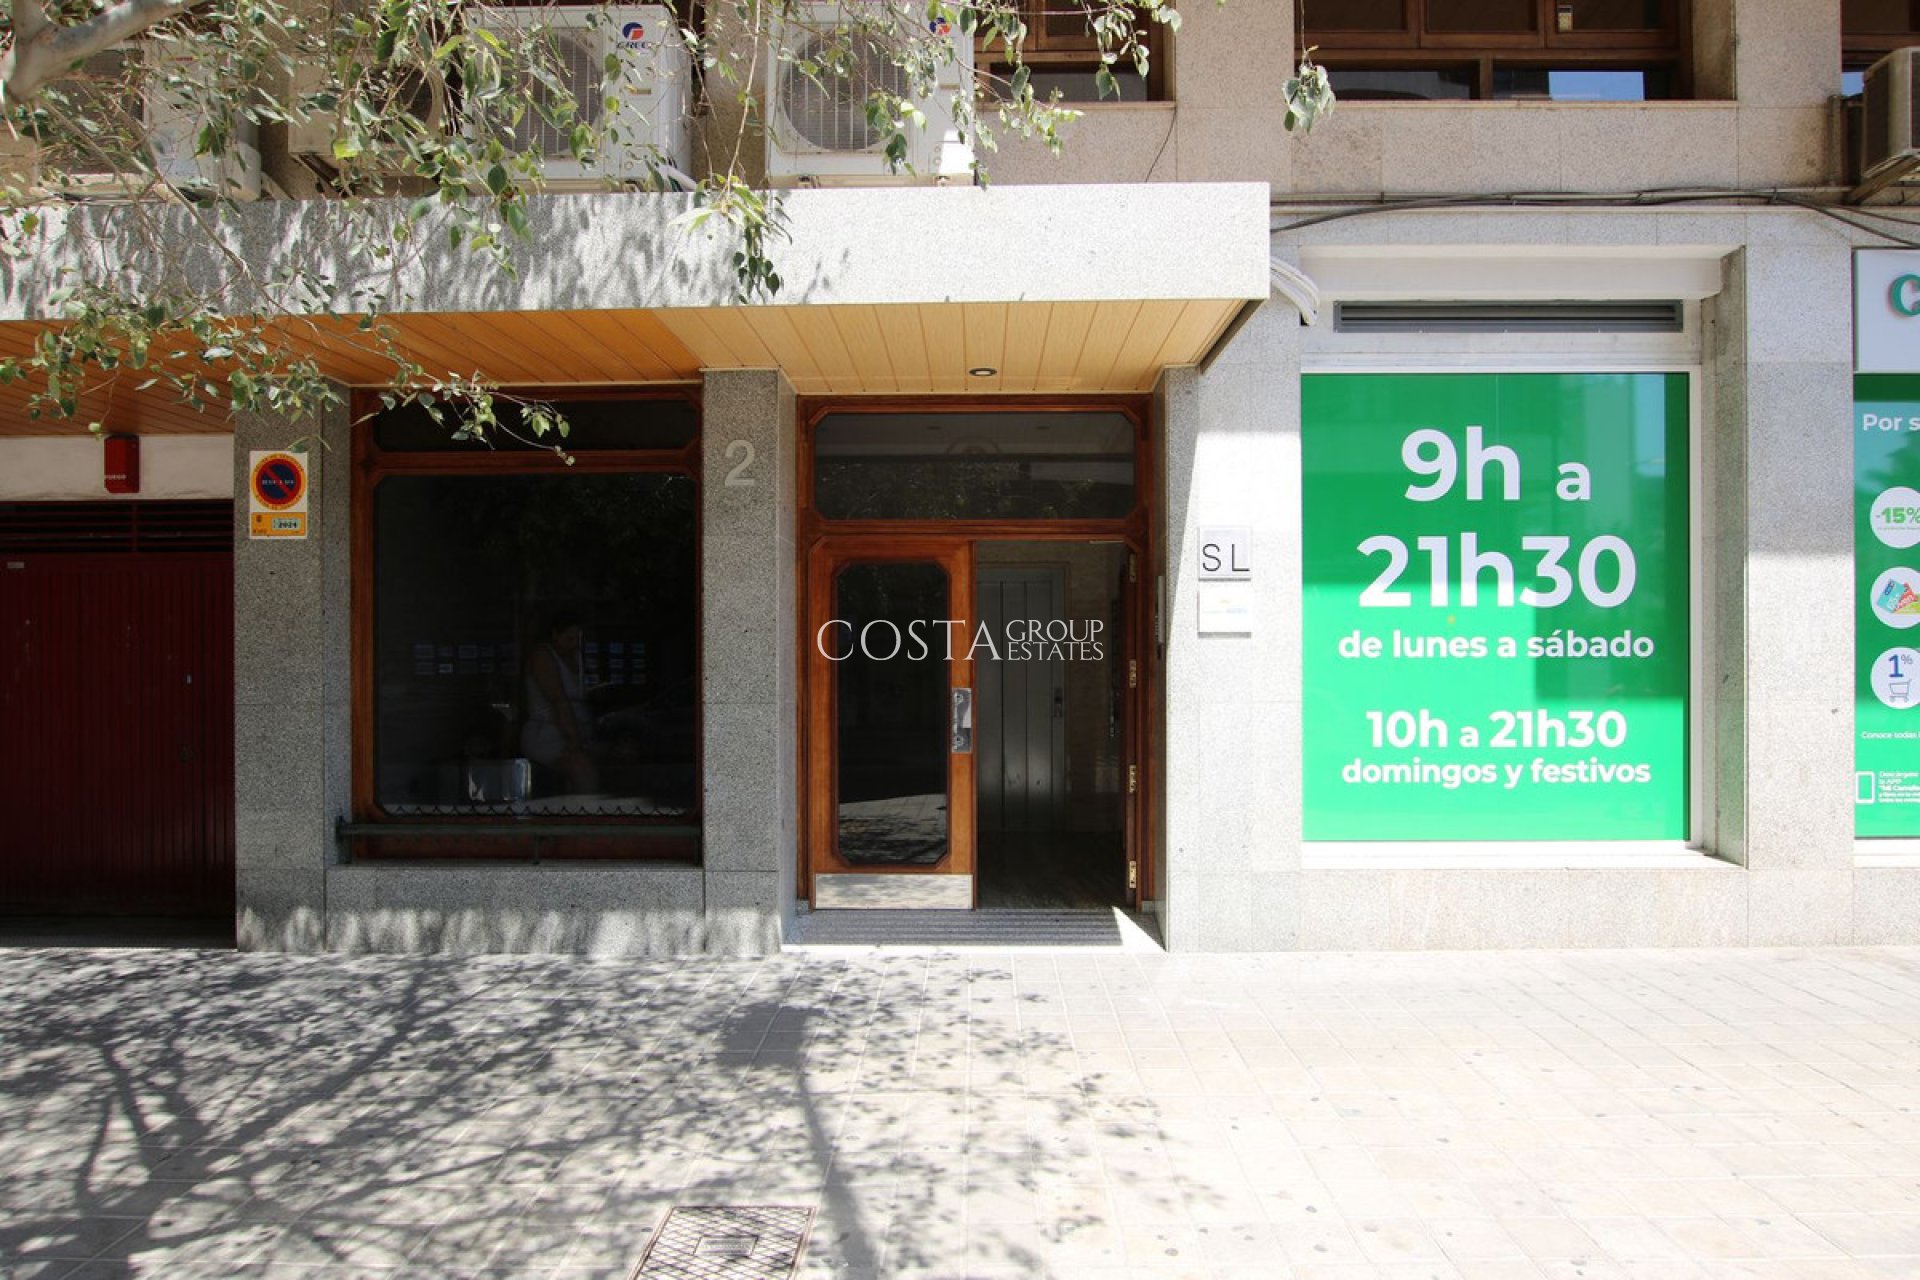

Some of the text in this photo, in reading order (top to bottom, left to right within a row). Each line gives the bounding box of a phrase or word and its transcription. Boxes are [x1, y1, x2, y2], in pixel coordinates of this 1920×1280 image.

[1863, 413, 1903, 431] Por
[725, 439, 755, 488] 2
[1401, 426, 1591, 502] 9h a
[1357, 532, 1636, 608] 21h30
[1338, 630, 1655, 659] de lunes a sábado
[1366, 709, 1628, 748] 10h a 21h30
[1341, 756, 1652, 790] domingos y festivos
